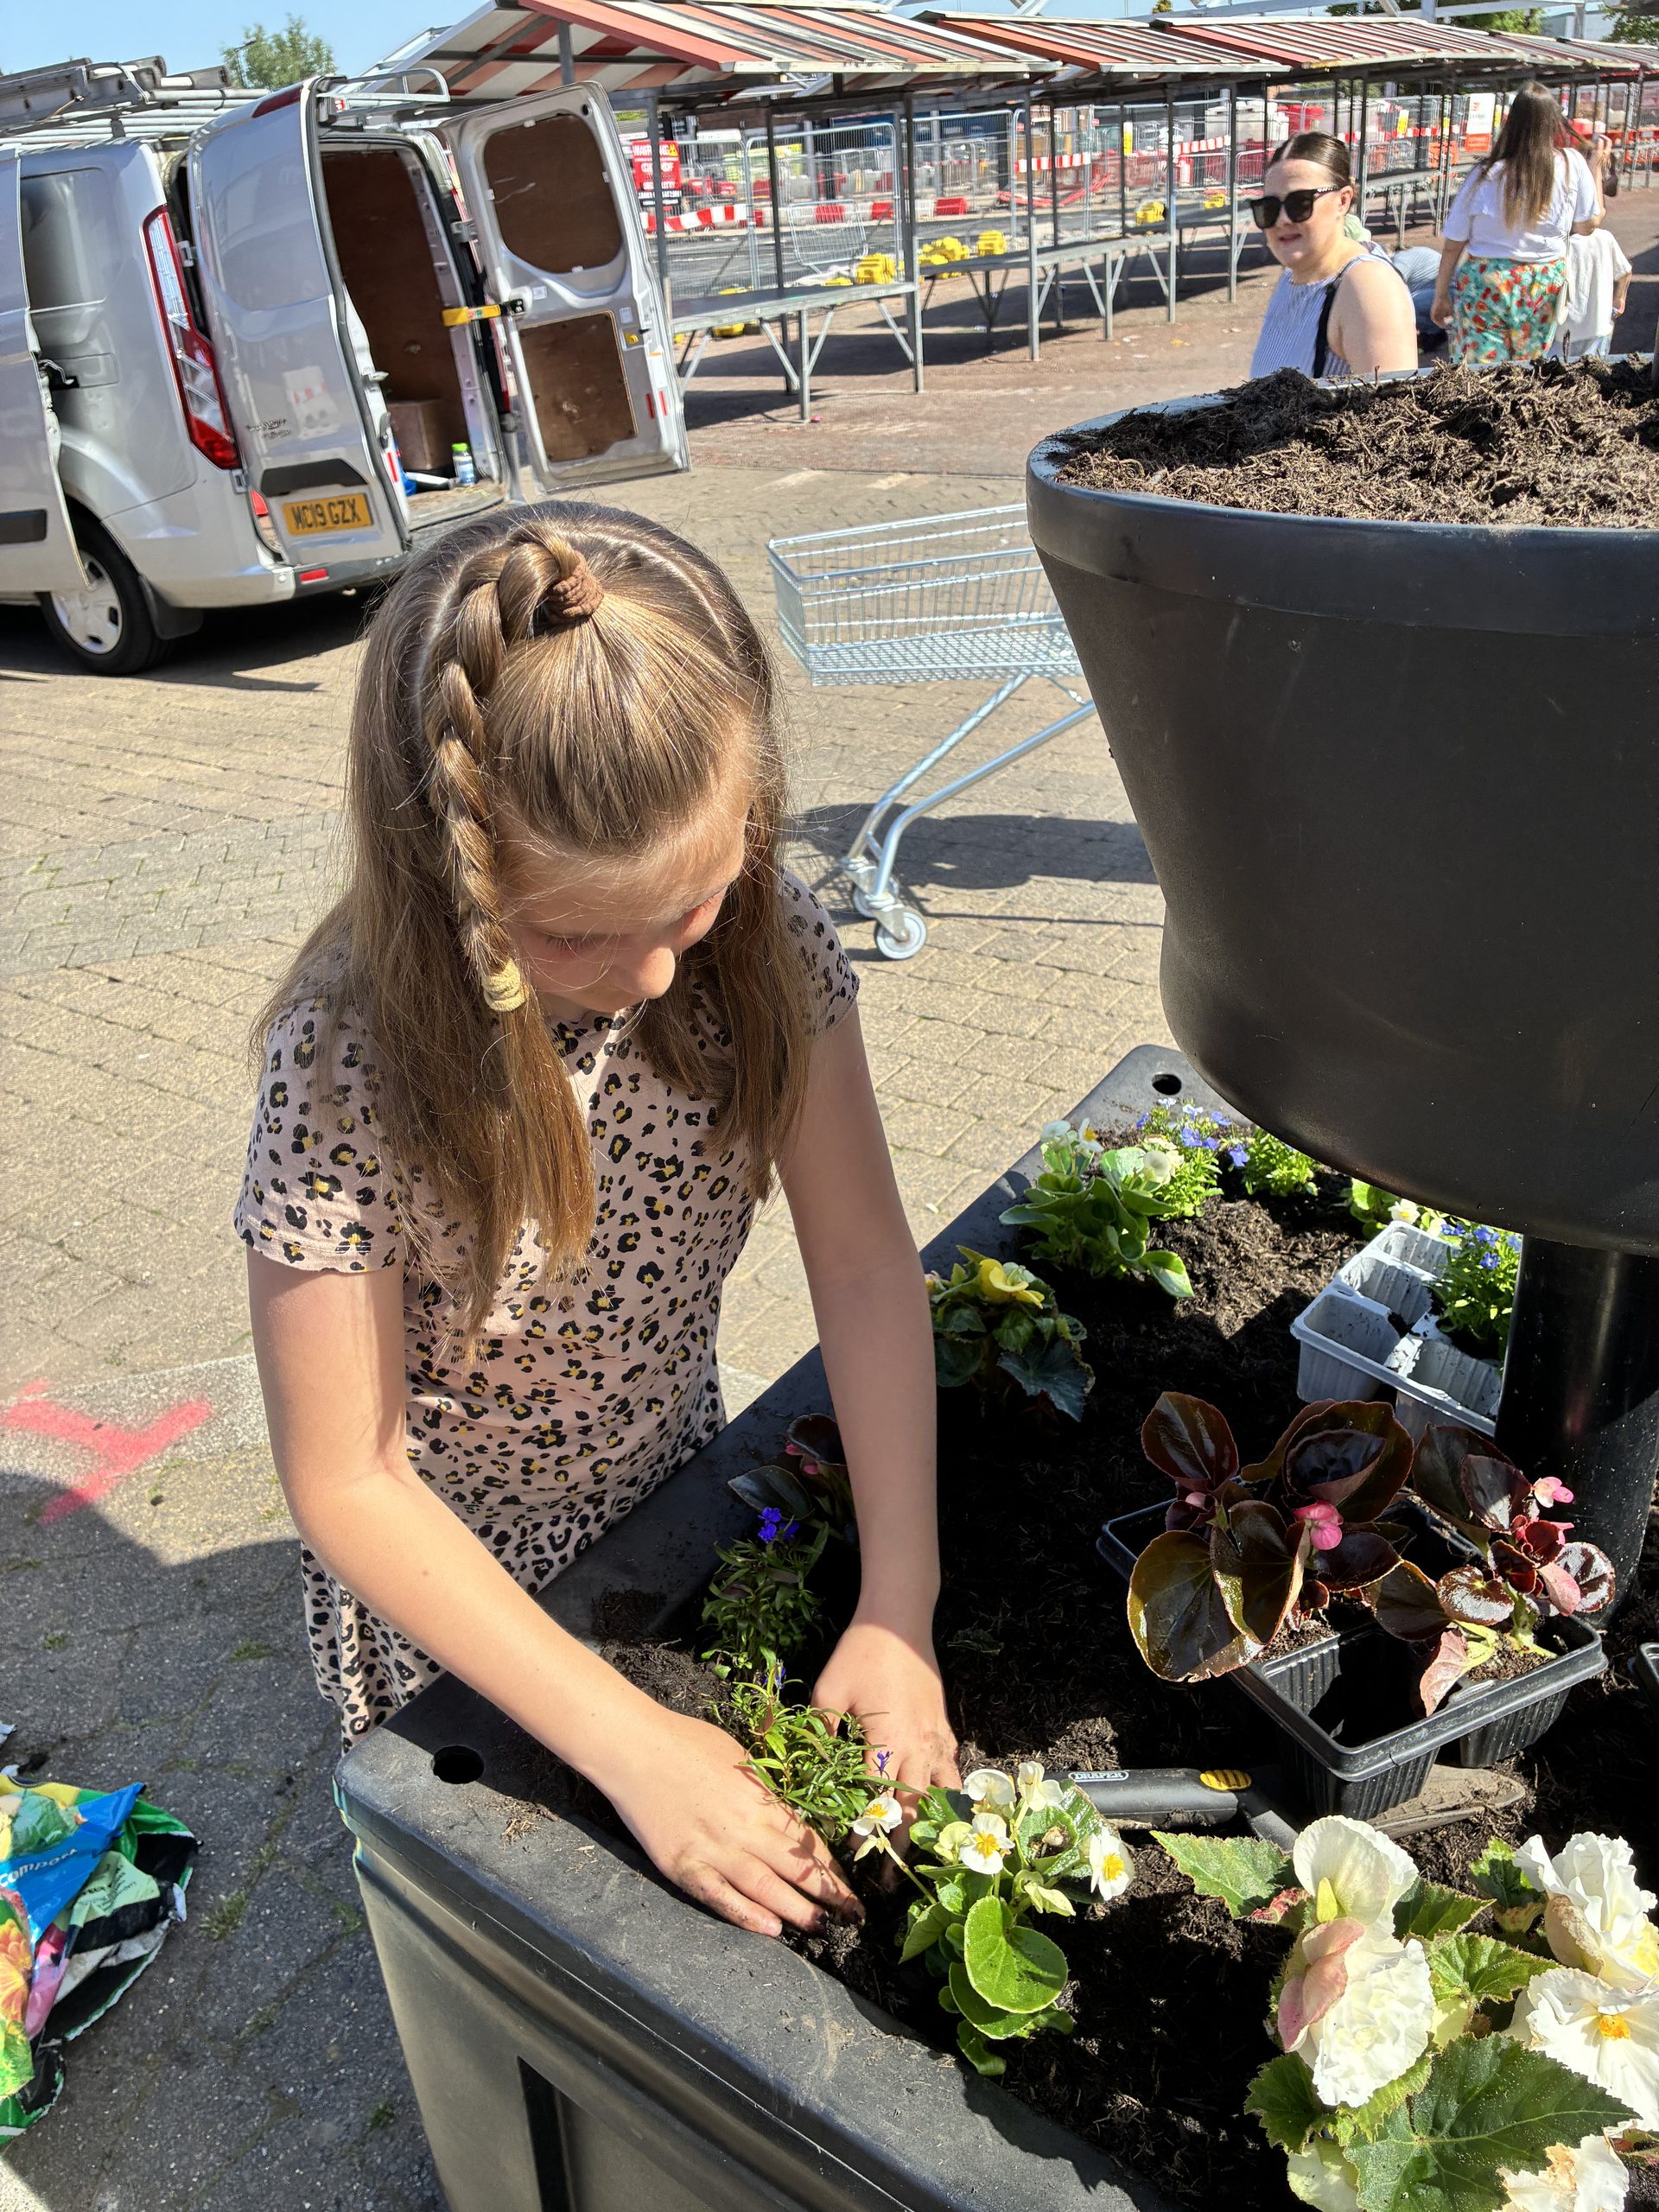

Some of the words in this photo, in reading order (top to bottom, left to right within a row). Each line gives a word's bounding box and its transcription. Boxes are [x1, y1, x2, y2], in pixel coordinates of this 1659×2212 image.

[290, 504, 327, 530] MC19
[327, 498, 361, 524] GZX
[1074, 1771, 1124, 1780] DRAPER
